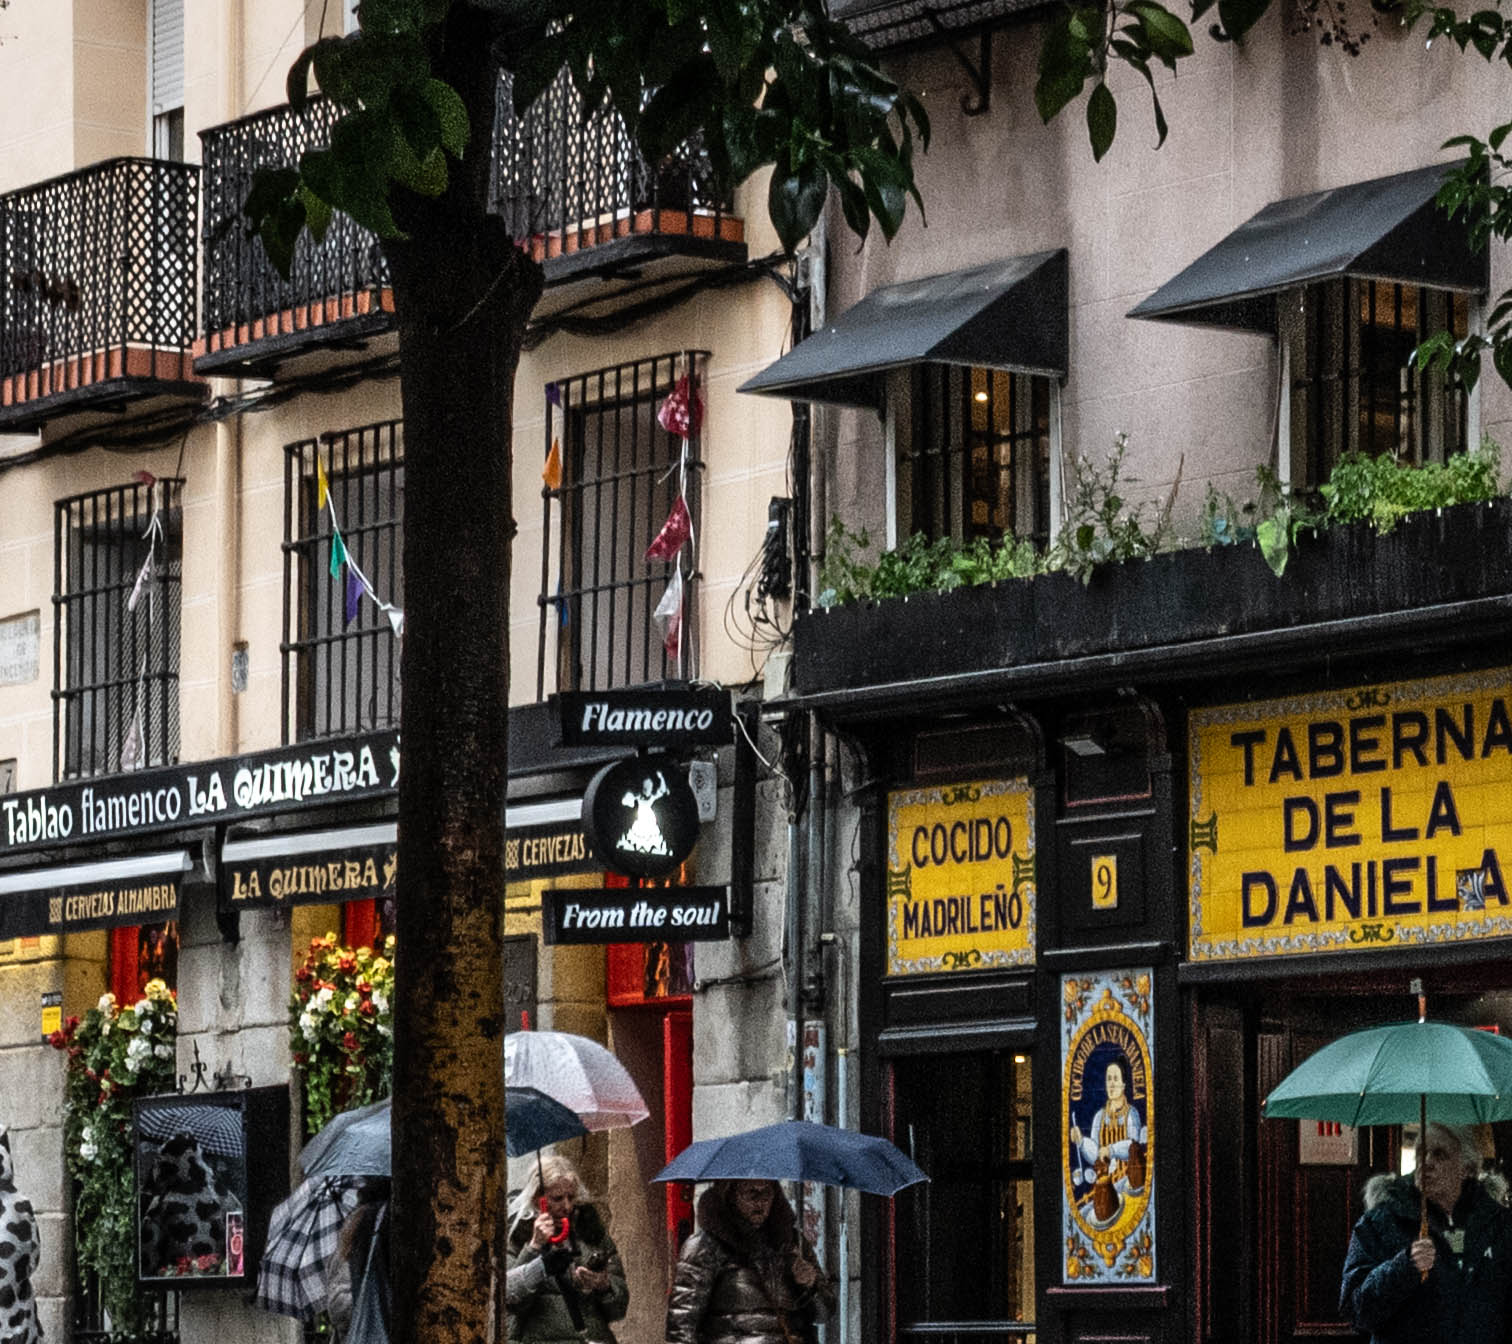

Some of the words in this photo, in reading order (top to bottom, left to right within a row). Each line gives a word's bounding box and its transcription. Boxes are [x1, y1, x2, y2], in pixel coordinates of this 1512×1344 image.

[581, 702, 713, 732] Flamenco
[2, 794, 73, 845] Tablao
[82, 786, 182, 834] flamenco
[188, 774, 227, 816] LA
[234, 746, 380, 810] QUIMERA
[1284, 790, 1361, 853] DE
[1381, 781, 1462, 844] LA
[523, 833, 585, 868] CERVEZAS
[912, 816, 1012, 868] COCIDO
[232, 869, 261, 900] LA
[269, 857, 378, 899] QUIMERA
[1097, 864, 1112, 900] 9
[1242, 849, 1511, 929] DANIELA
[65, 891, 115, 922] CERVEZAS
[117, 883, 177, 916] ALHAMBRA
[563, 903, 624, 929] From
[630, 900, 668, 928] the
[671, 900, 720, 927] soul
[903, 884, 1023, 939] MADRILEÑO
[1092, 1024, 1107, 1045] LA
